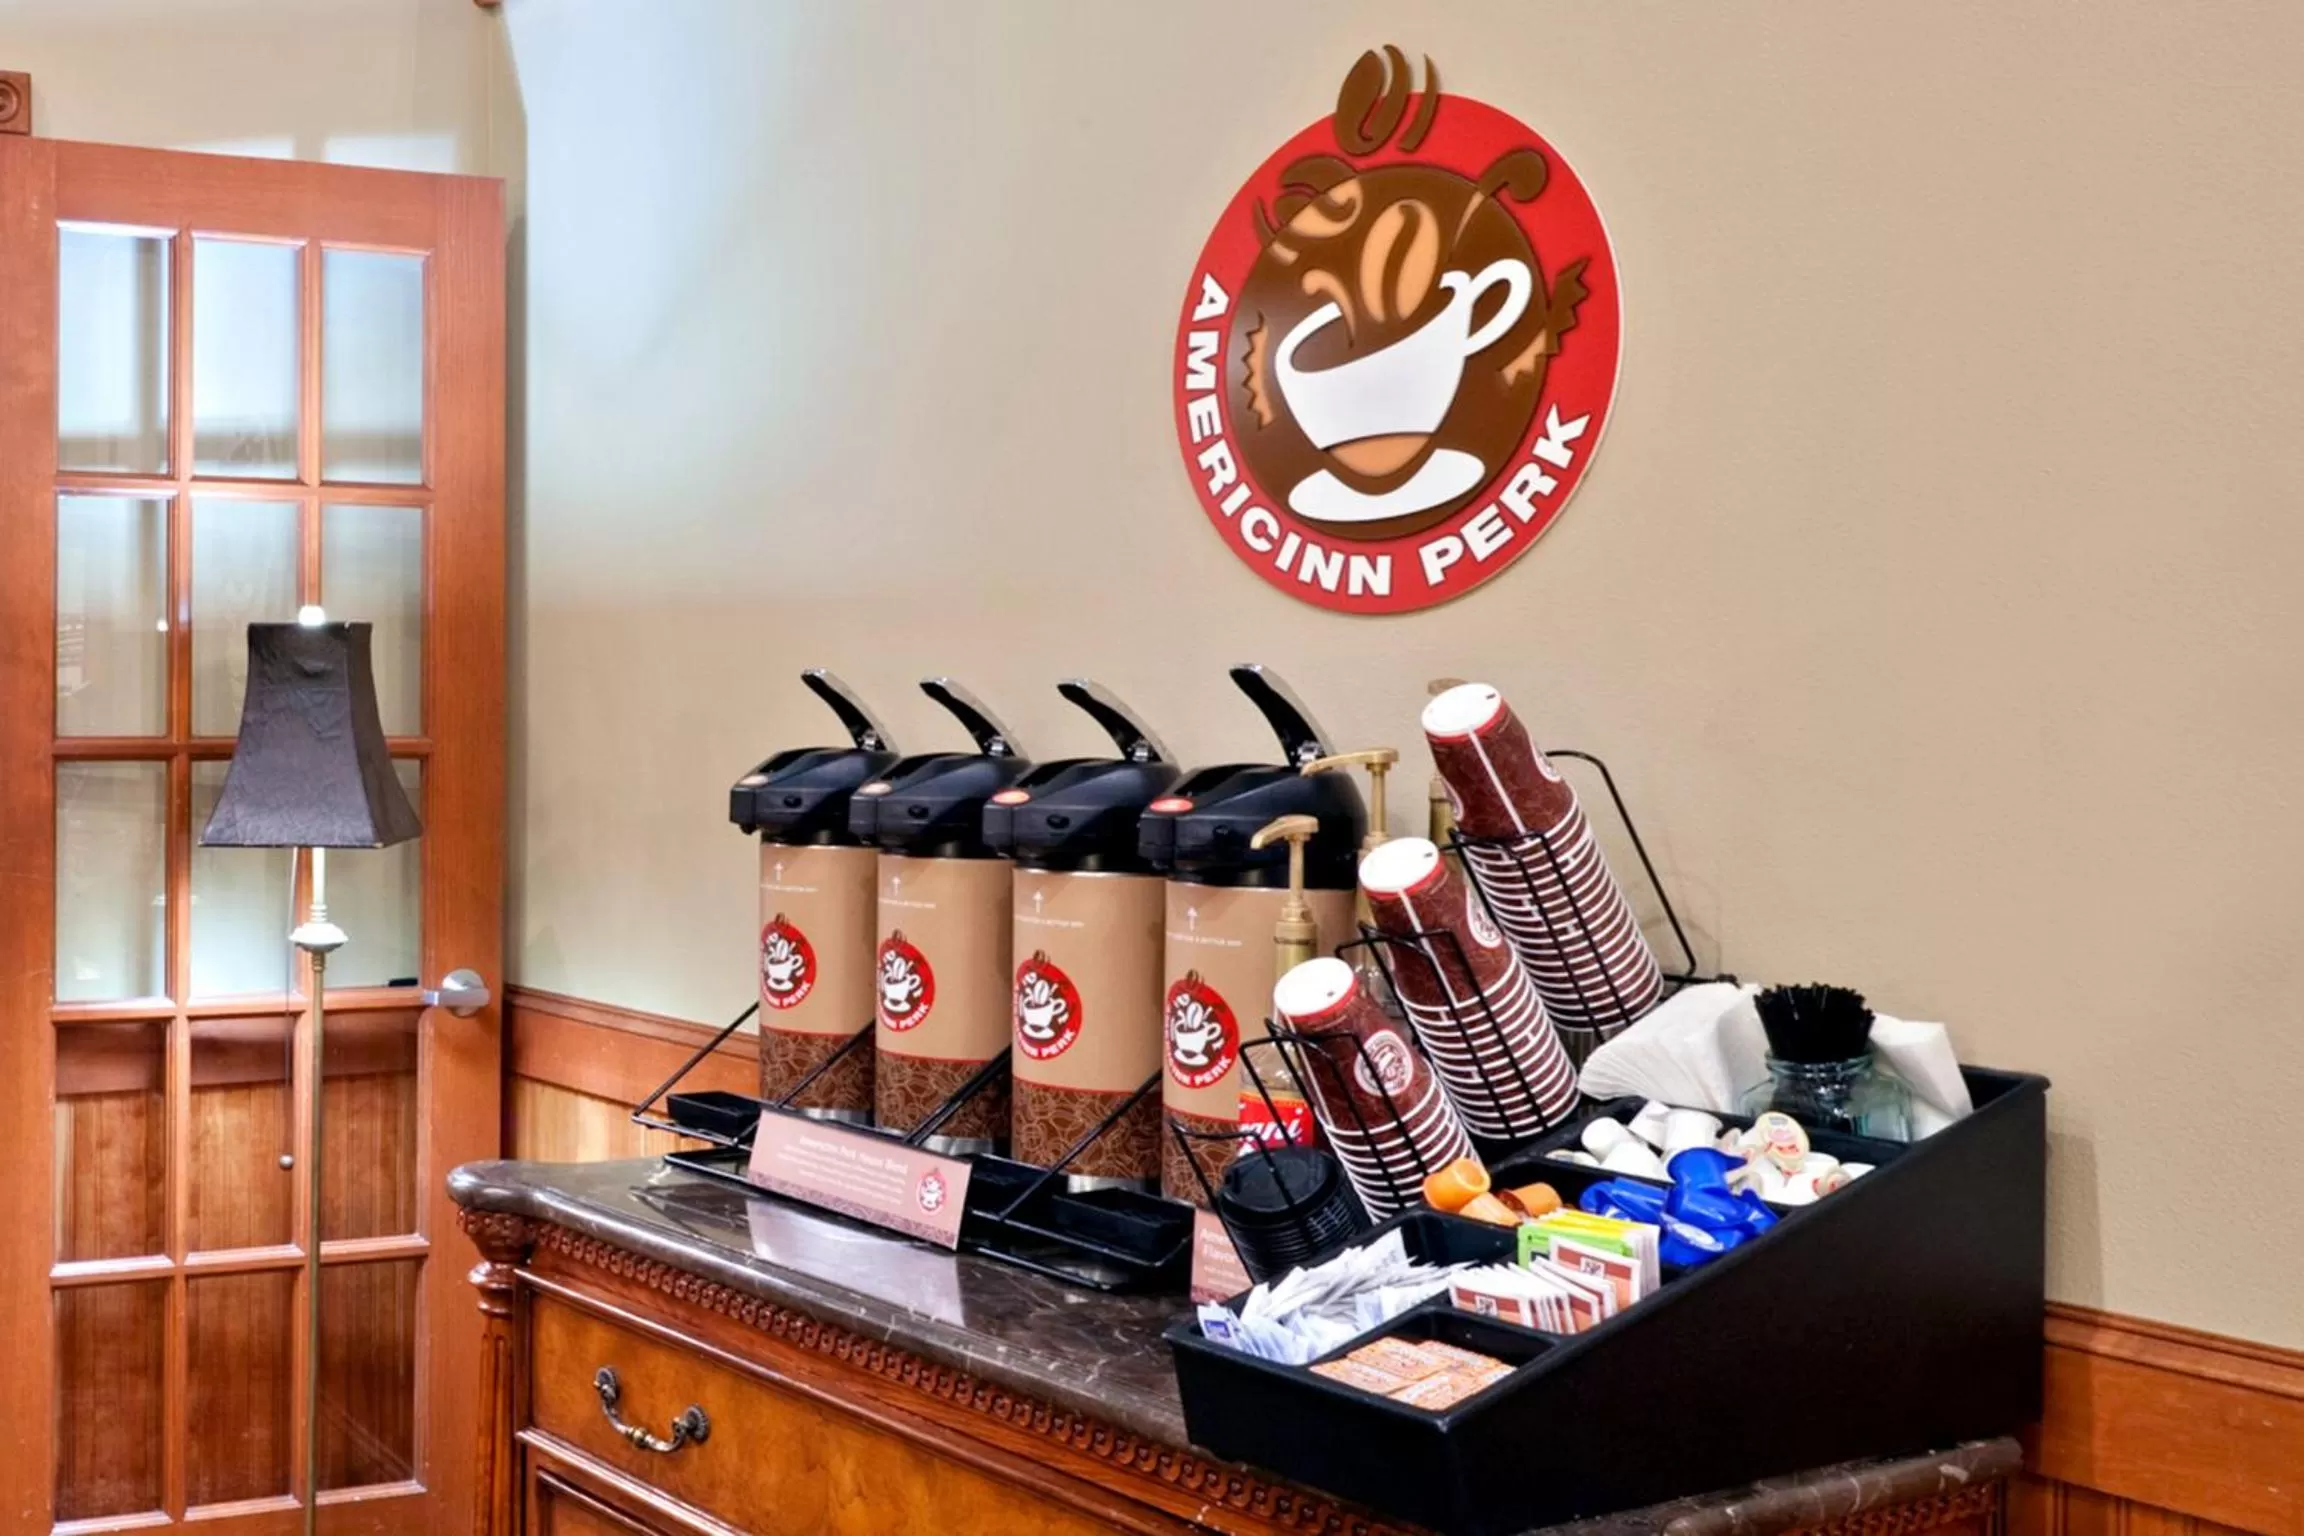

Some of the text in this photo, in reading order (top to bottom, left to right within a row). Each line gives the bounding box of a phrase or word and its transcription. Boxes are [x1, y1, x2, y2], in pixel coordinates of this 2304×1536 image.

[1186, 272, 1591, 597] AMERICINN PERK
[1041, 1028, 1076, 1058] PERK
[1194, 1055, 1232, 1085] PERK
